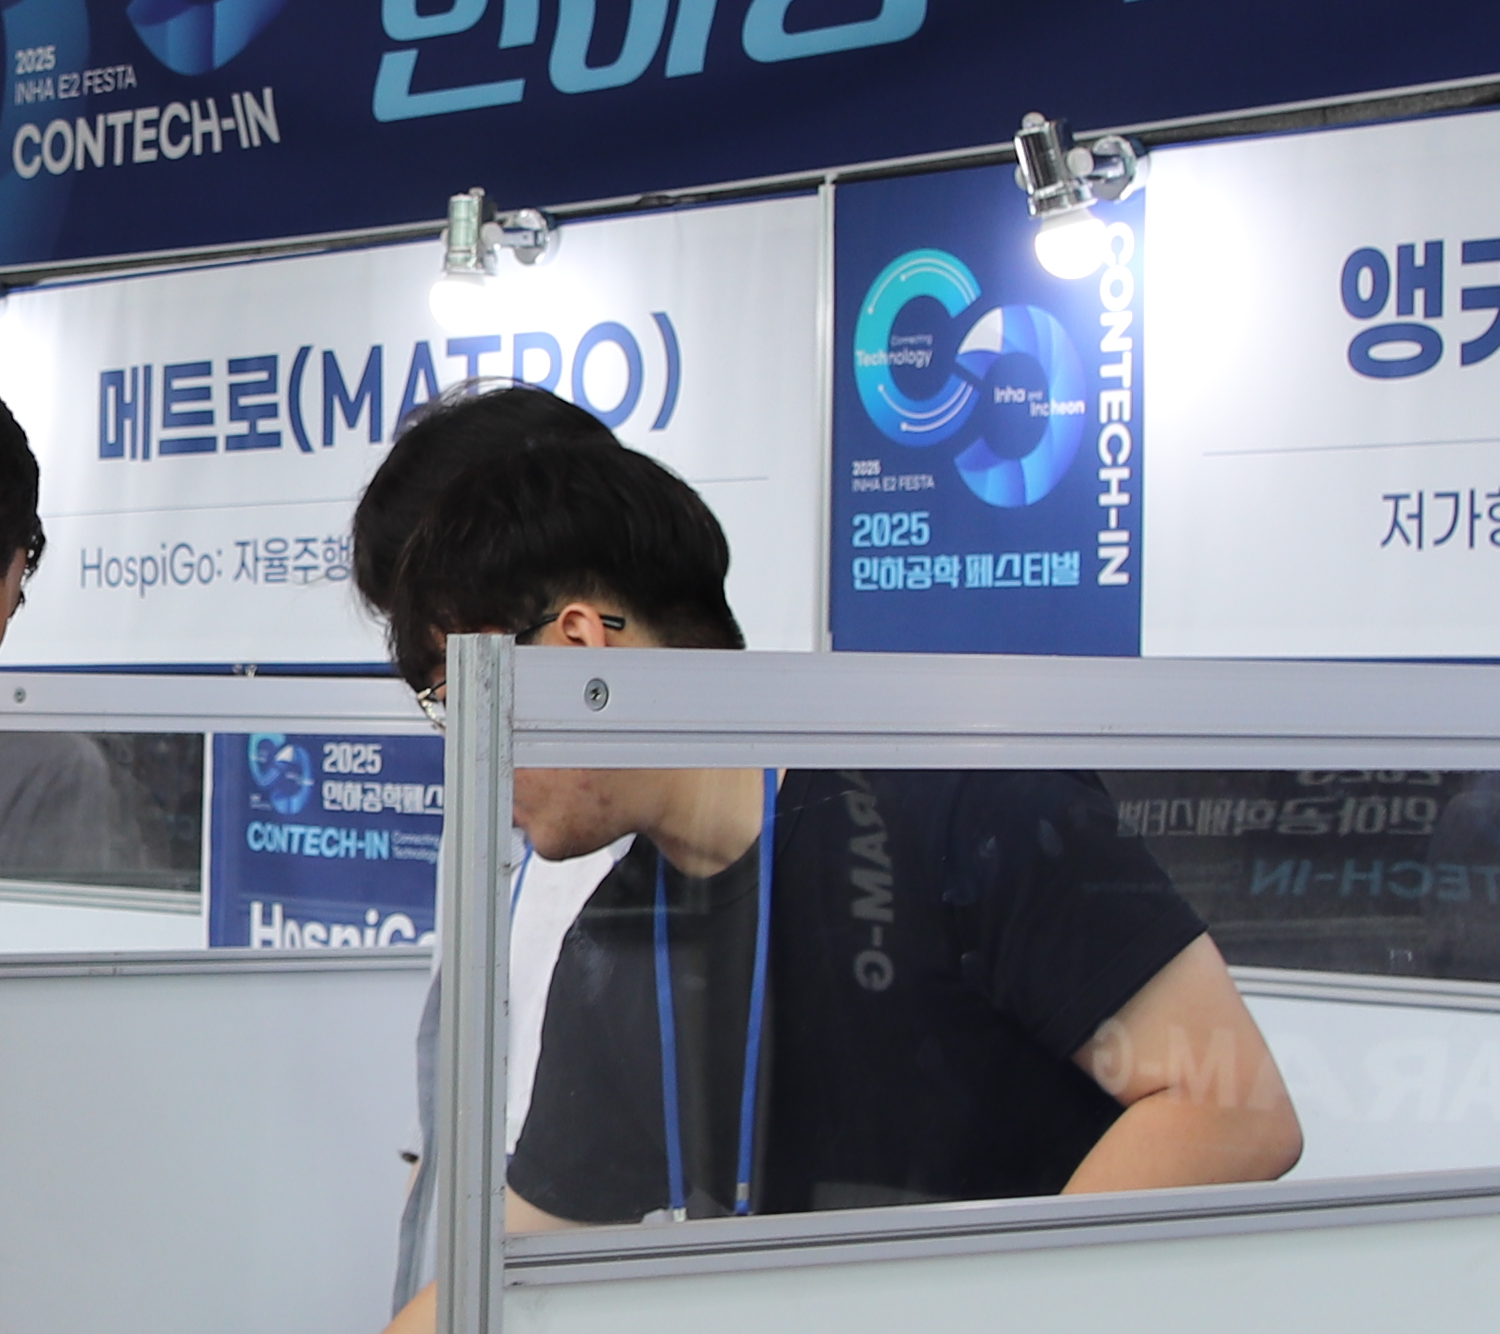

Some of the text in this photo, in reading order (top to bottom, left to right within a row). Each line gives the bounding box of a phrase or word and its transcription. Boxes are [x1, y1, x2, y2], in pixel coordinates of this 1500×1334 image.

[14, 45, 57, 75] 2025
[14, 64, 138, 105] INHA E2 FESTA
[12, 87, 282, 180] CONTECH-IN
[855, 348, 934, 369] Technology
[994, 385, 1027, 405] Inha
[1029, 398, 1086, 418] Incheon
[1097, 220, 1136, 587] CONTECH-IN
[852, 477, 881, 493] INHA
[898, 474, 935, 491] FESTA
[851, 511, 932, 549] 2025
[79, 533, 356, 601] HospiGo: 자율주행
[852, 549, 1081, 592] 인하공학 페스티벌
[322, 742, 383, 775] 2025
[246, 820, 390, 861] CONTECH-IN
